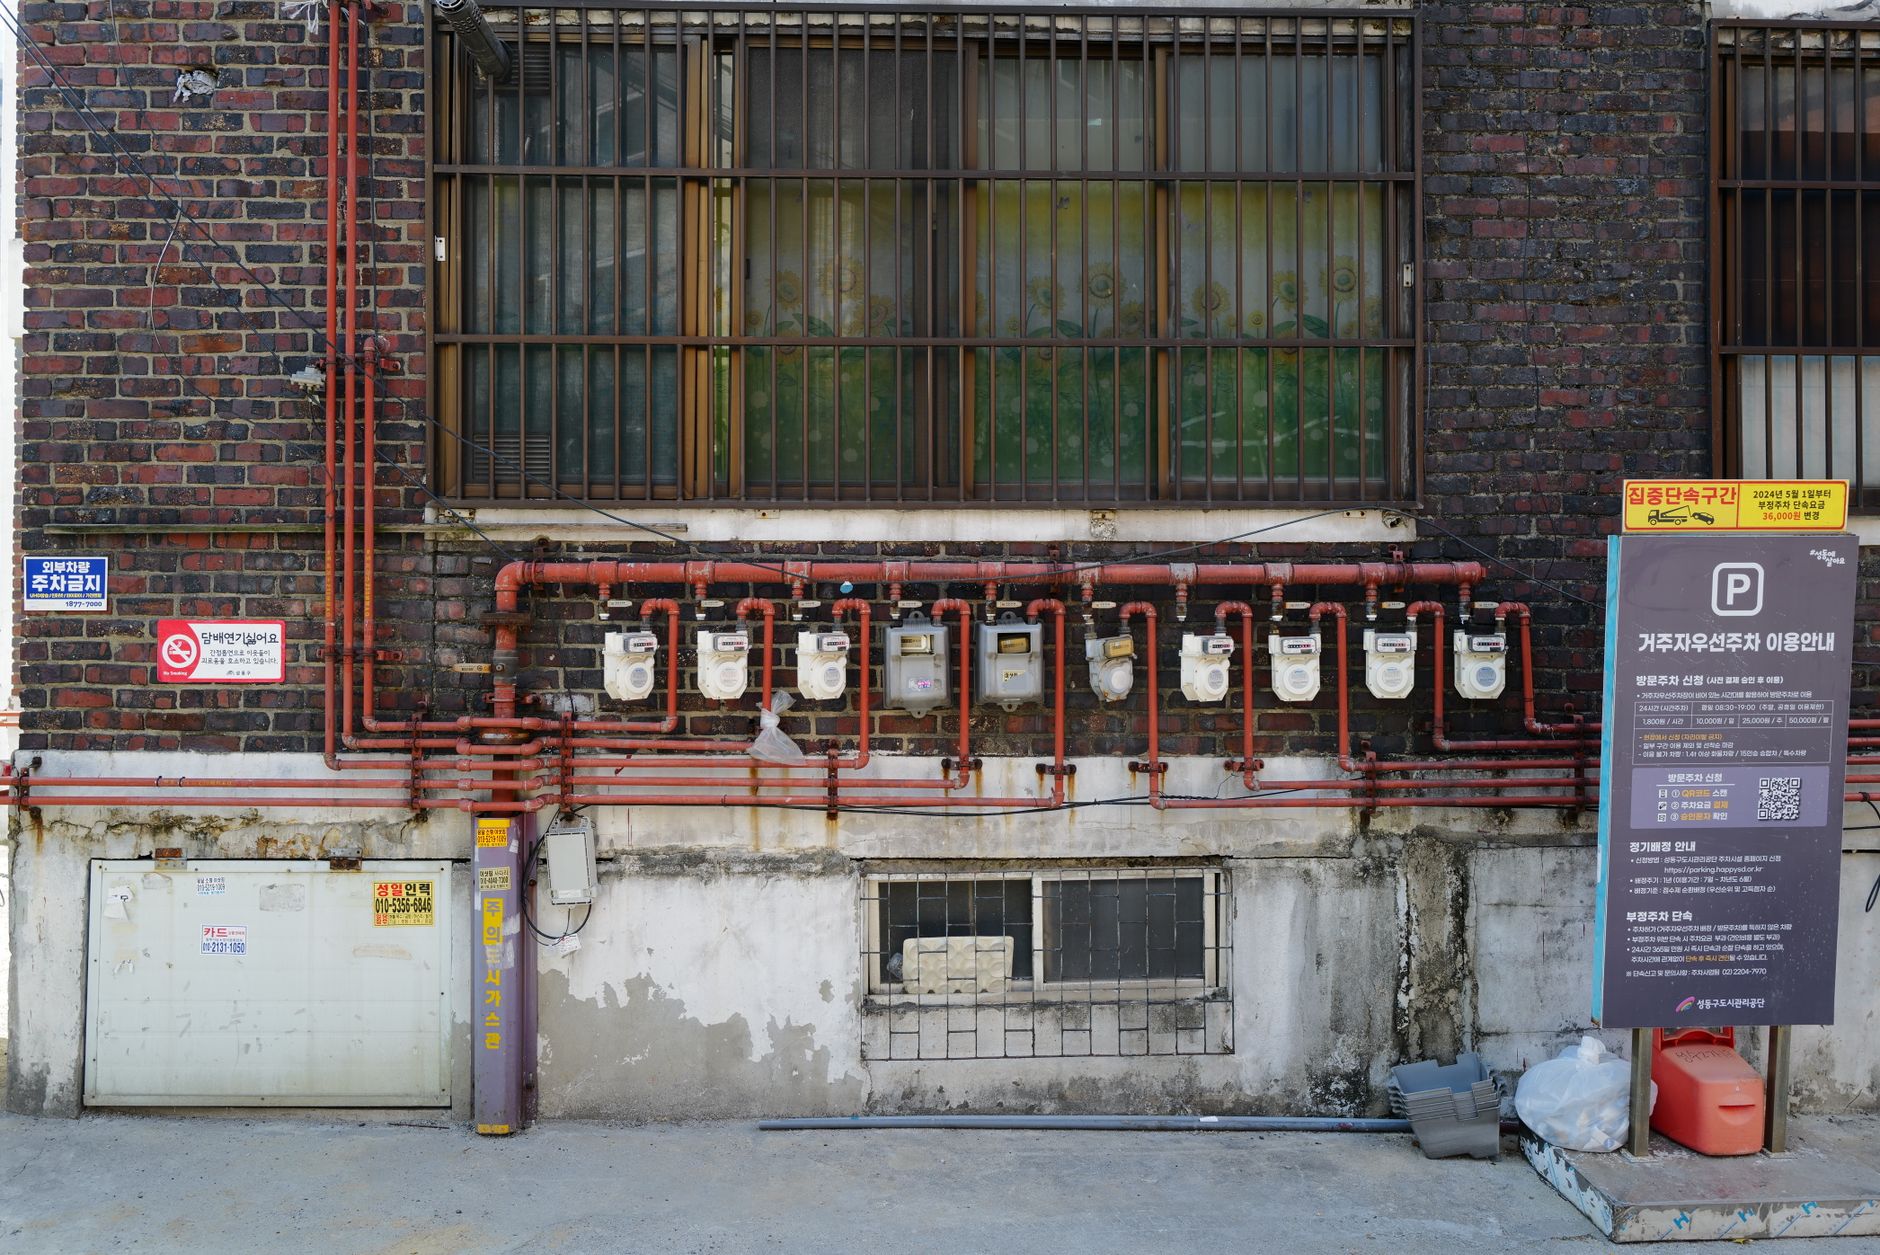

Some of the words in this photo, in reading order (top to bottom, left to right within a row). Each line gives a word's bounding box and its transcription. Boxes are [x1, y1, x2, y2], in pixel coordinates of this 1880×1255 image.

[1628, 487, 1736, 506] 집중단속구간
[1753, 490, 1783, 500] 2024년
[1785, 490, 1800, 499] 5월
[1802, 489, 1832, 499] 1일부터
[1758, 501, 1790, 510] 부정주차
[1794, 501, 1826, 510] 단속요금
[1763, 511, 1801, 521] 36,000원
[1804, 511, 1820, 520] 변경
[42, 561, 90, 573] 외부차량
[32, 574, 100, 592] 주차금지
[1727, 574, 1751, 605] P
[1639, 632, 1760, 653] 거주자우선주차
[1766, 632, 1835, 652] 이용안내
[1636, 675, 1680, 686] 방문주차
[1683, 675, 1704, 686] 신청
[1707, 677, 1724, 685] (사전
[1726, 676, 1740, 684] 결제
[1741, 676, 1755, 684] 승인
[1766, 676, 1784, 684] 이용)
[1668, 774, 1703, 783] 방문주차
[1705, 773, 1723, 782] 신청
[1681, 790, 1711, 798] QR코드
[1712, 789, 1728, 797] 스캔
[1712, 812, 1728, 820] 확인
[1630, 841, 1672, 853] 정기배정
[1675, 841, 1696, 852] 안내
[1664, 866, 1764, 874] https://parking.happysd.or.kr
[377, 883, 430, 896] 성일인력
[376, 898, 432, 913] 010-5356-6846
[1626, 911, 1669, 922] 부정주차
[1672, 911, 1693, 922] 단속
[486, 902, 500, 943] 주의
[204, 928, 228, 938] 카드
[203, 942, 245, 953] 010-2131-1050
[1733, 968, 1767, 976] 2204-7970
[1697, 998, 1765, 1010] 성동구도시관리공단
